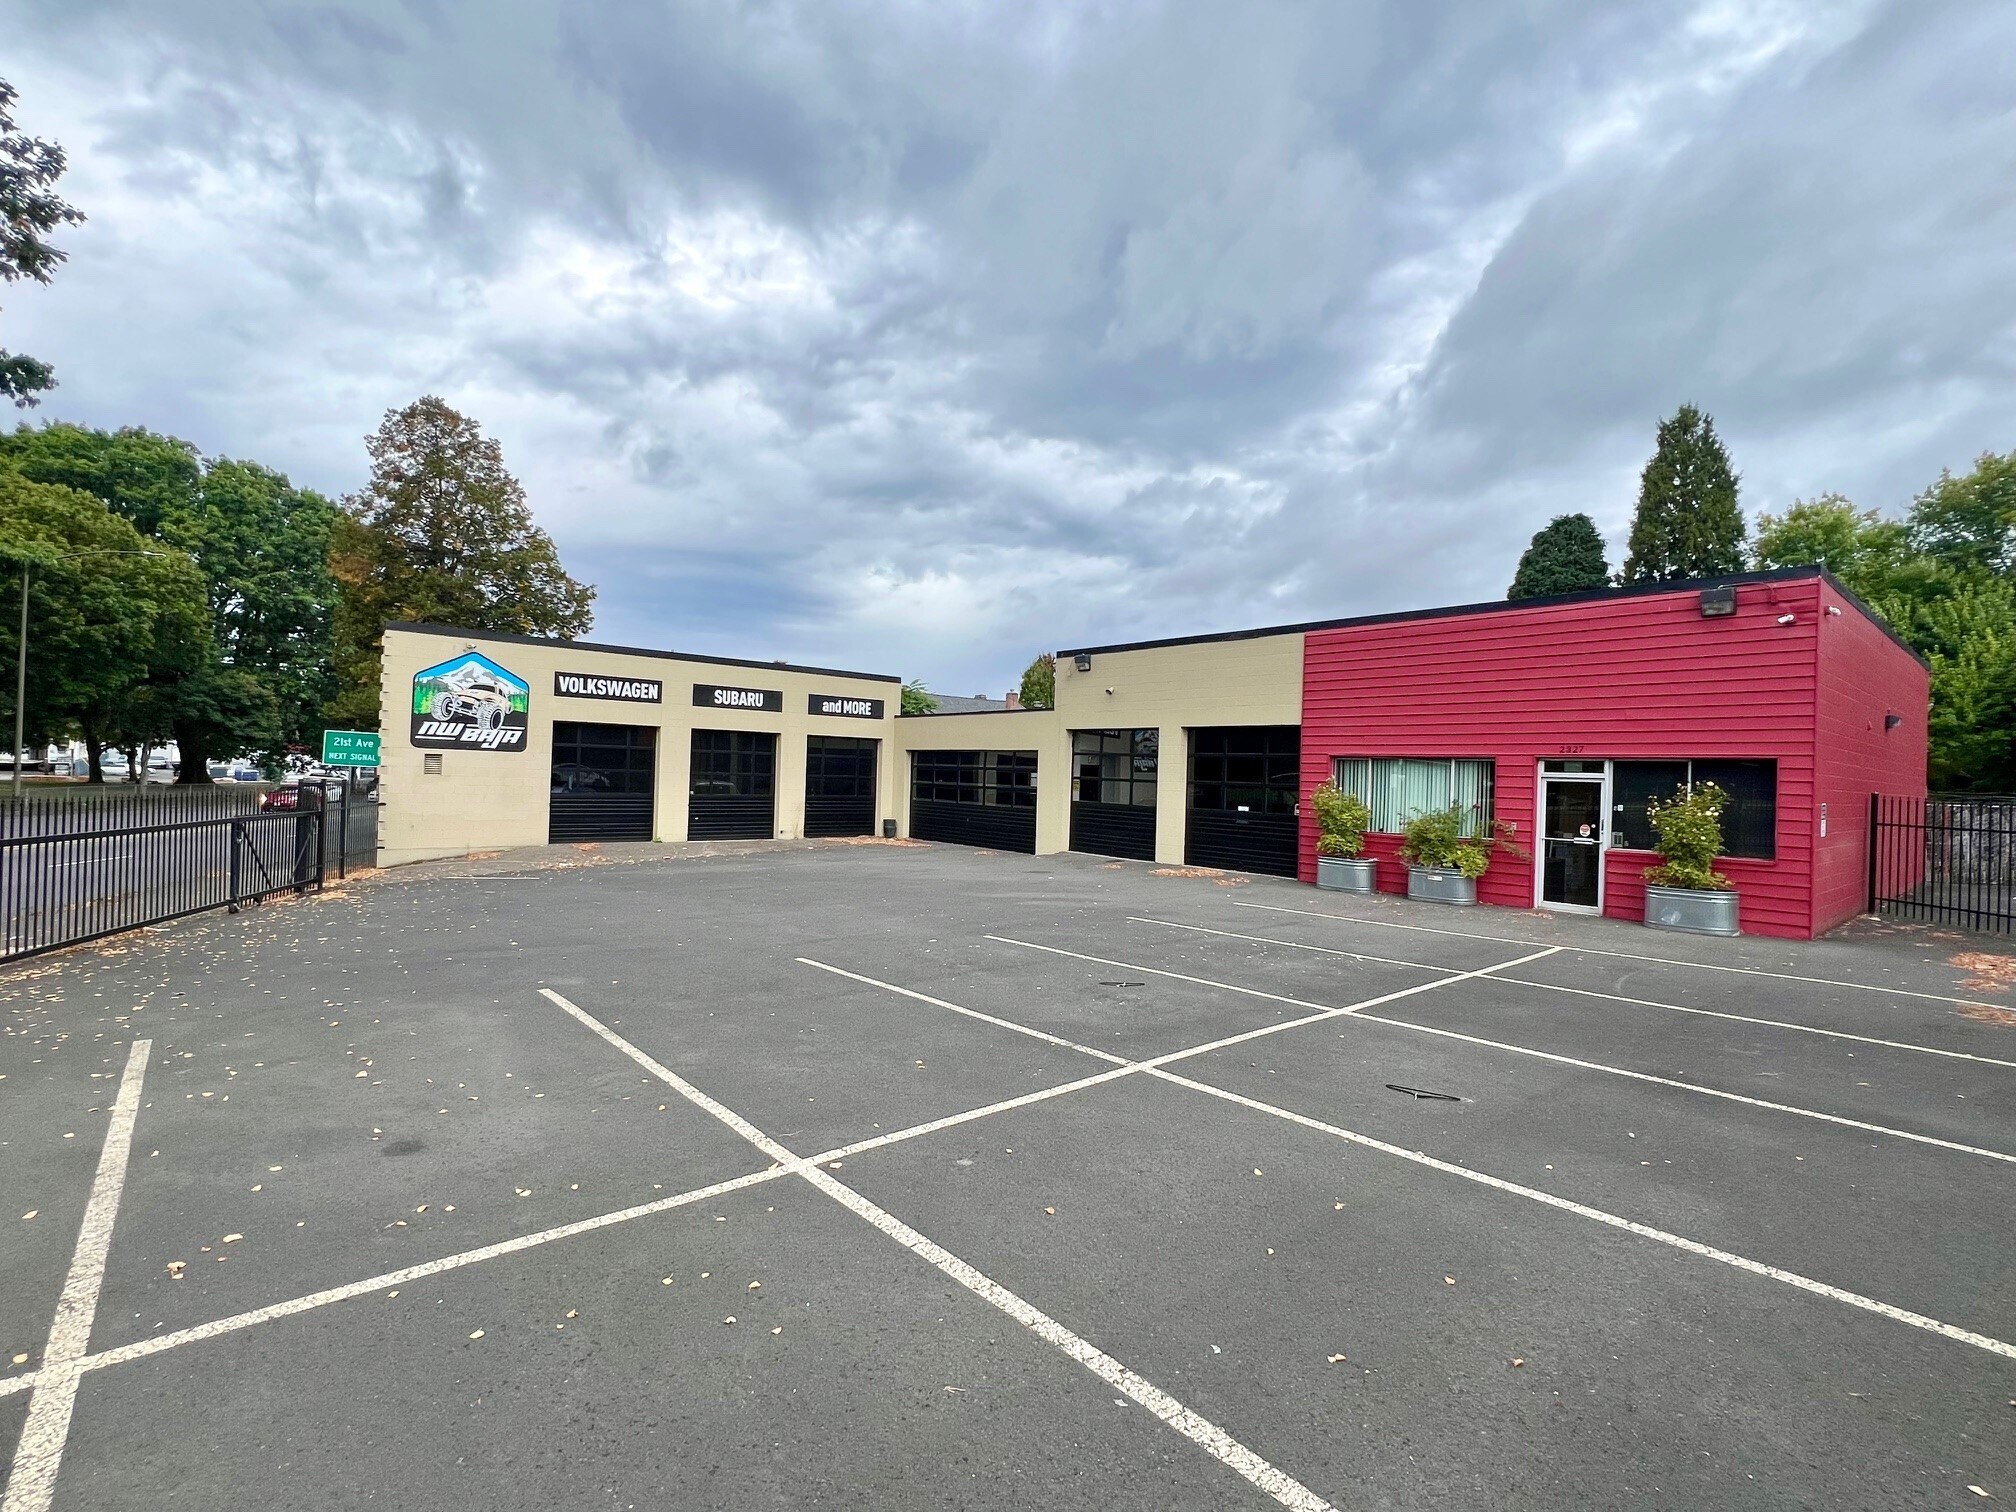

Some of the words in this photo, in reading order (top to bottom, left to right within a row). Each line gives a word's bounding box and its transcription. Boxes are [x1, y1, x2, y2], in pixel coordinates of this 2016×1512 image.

[558, 675, 659, 700] VOLKSWAGEN
[714, 689, 764, 708] SUBARU
[822, 700, 842, 714] and
[843, 700, 872, 716] MORE
[333, 737, 352, 747] 21st
[356, 738, 374, 748] Ave
[460, 728, 523, 749] BAJA
[328, 752, 347, 760] NEXT
[350, 753, 377, 762] SIGNAL
[1559, 745, 1585, 753] 2327
